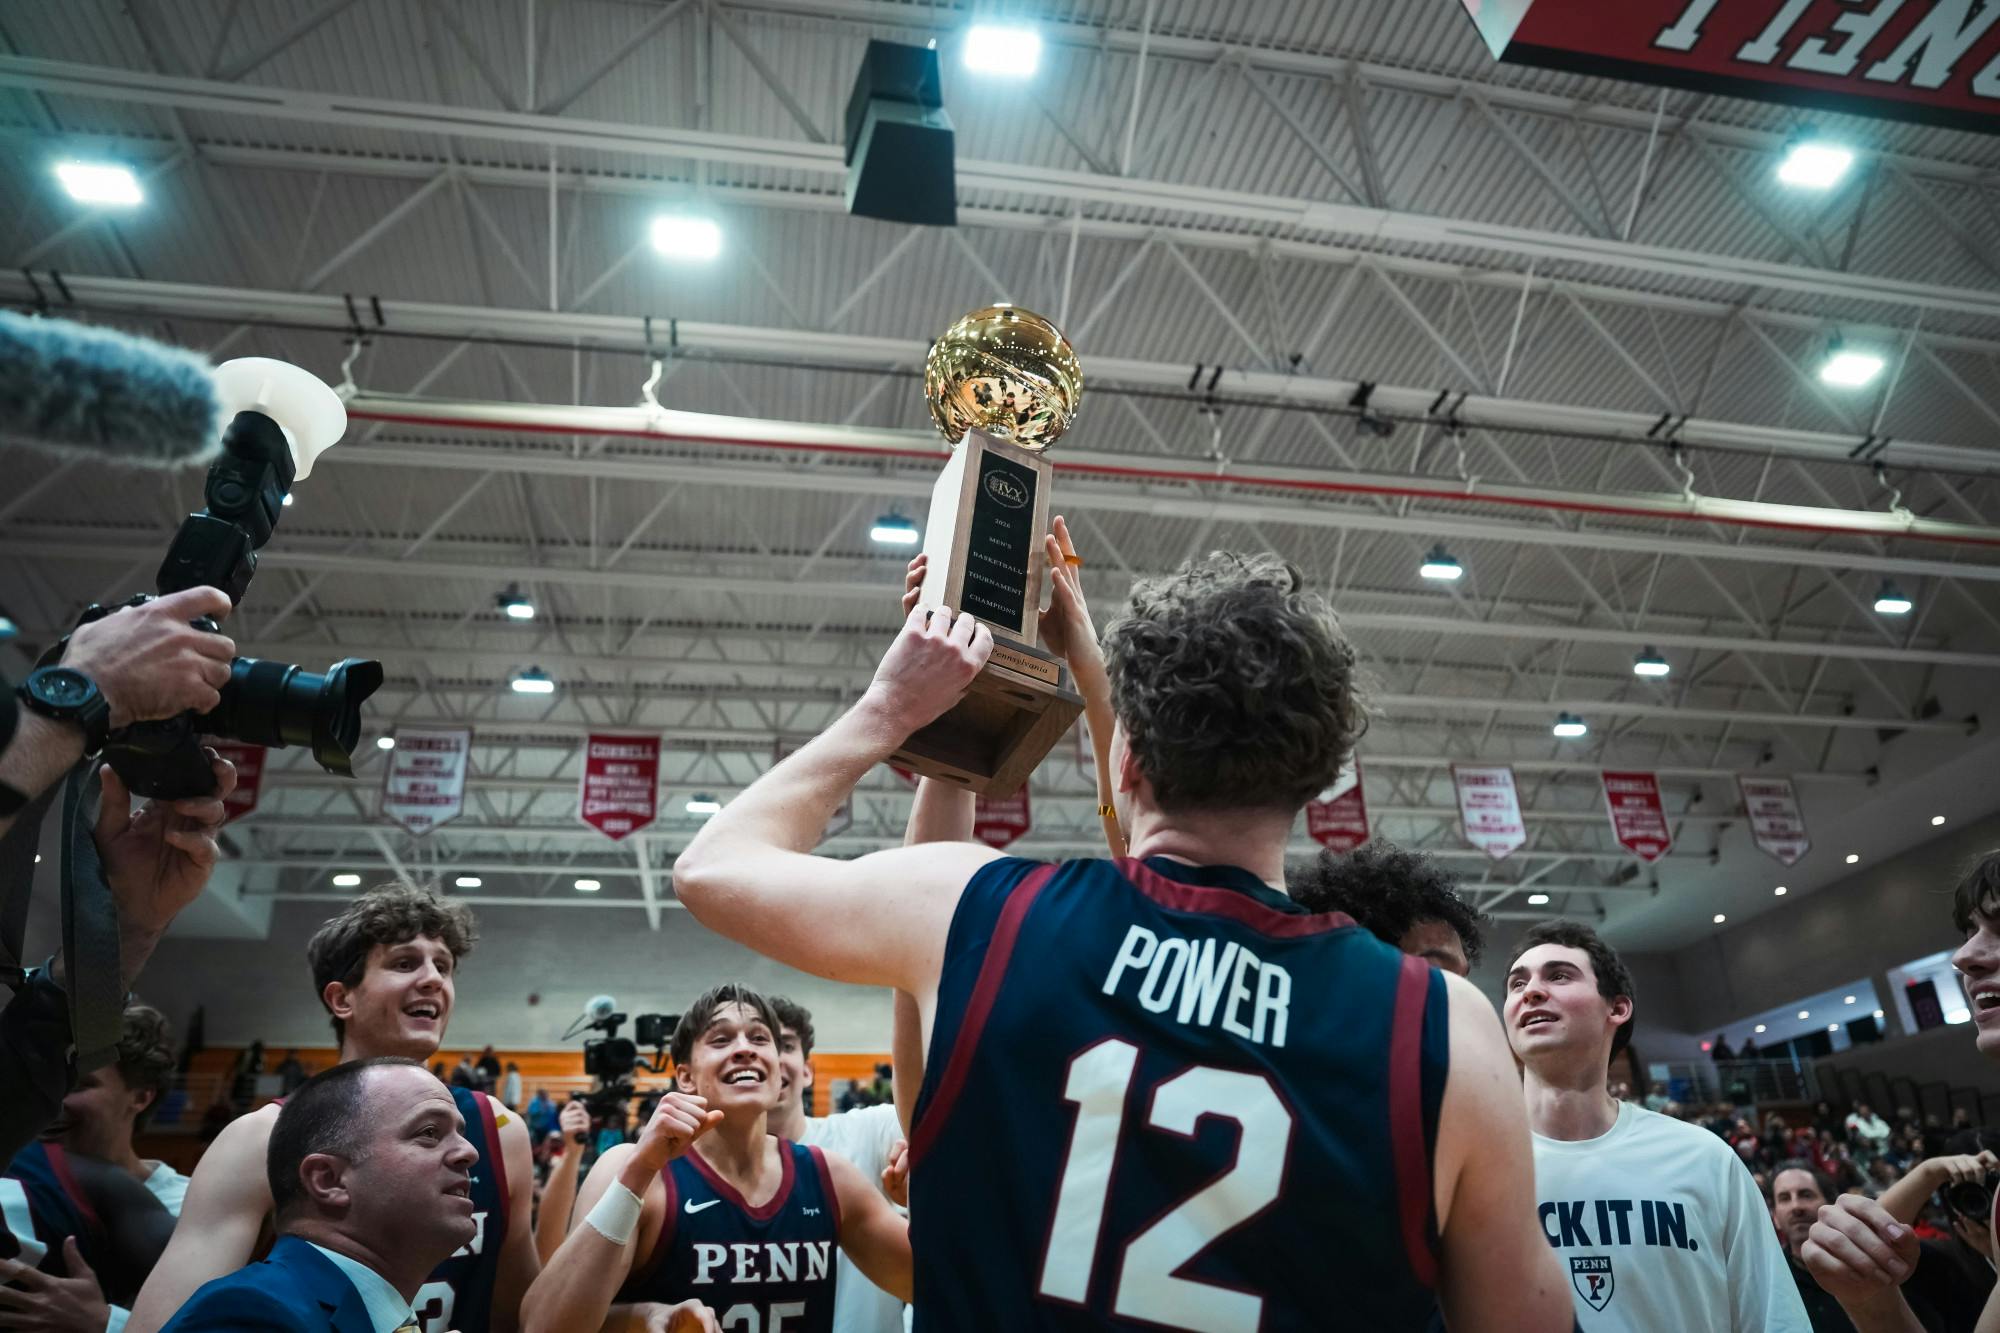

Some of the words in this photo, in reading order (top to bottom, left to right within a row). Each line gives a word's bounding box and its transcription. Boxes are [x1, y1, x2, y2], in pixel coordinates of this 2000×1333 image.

[999, 482, 1022, 497] IVY
[989, 536, 1012, 550] MEN'S
[973, 551, 1023, 575] BASKETBALL
[968, 571, 1022, 596] TOURNAMENT
[969, 593, 1017, 616] CHAMPIONS
[992, 647, 1048, 674] Pennsylvania
[592, 743, 655, 760] CORNELL
[1102, 924, 1292, 1047] POWER
[1037, 1037, 1296, 1333] 12
[1537, 1201, 1593, 1248] CK
[1595, 1200, 1633, 1246] IT
[1640, 1200, 1698, 1252] IN.
[691, 1241, 831, 1284] PENN
[1573, 1259, 1609, 1270] PENN
